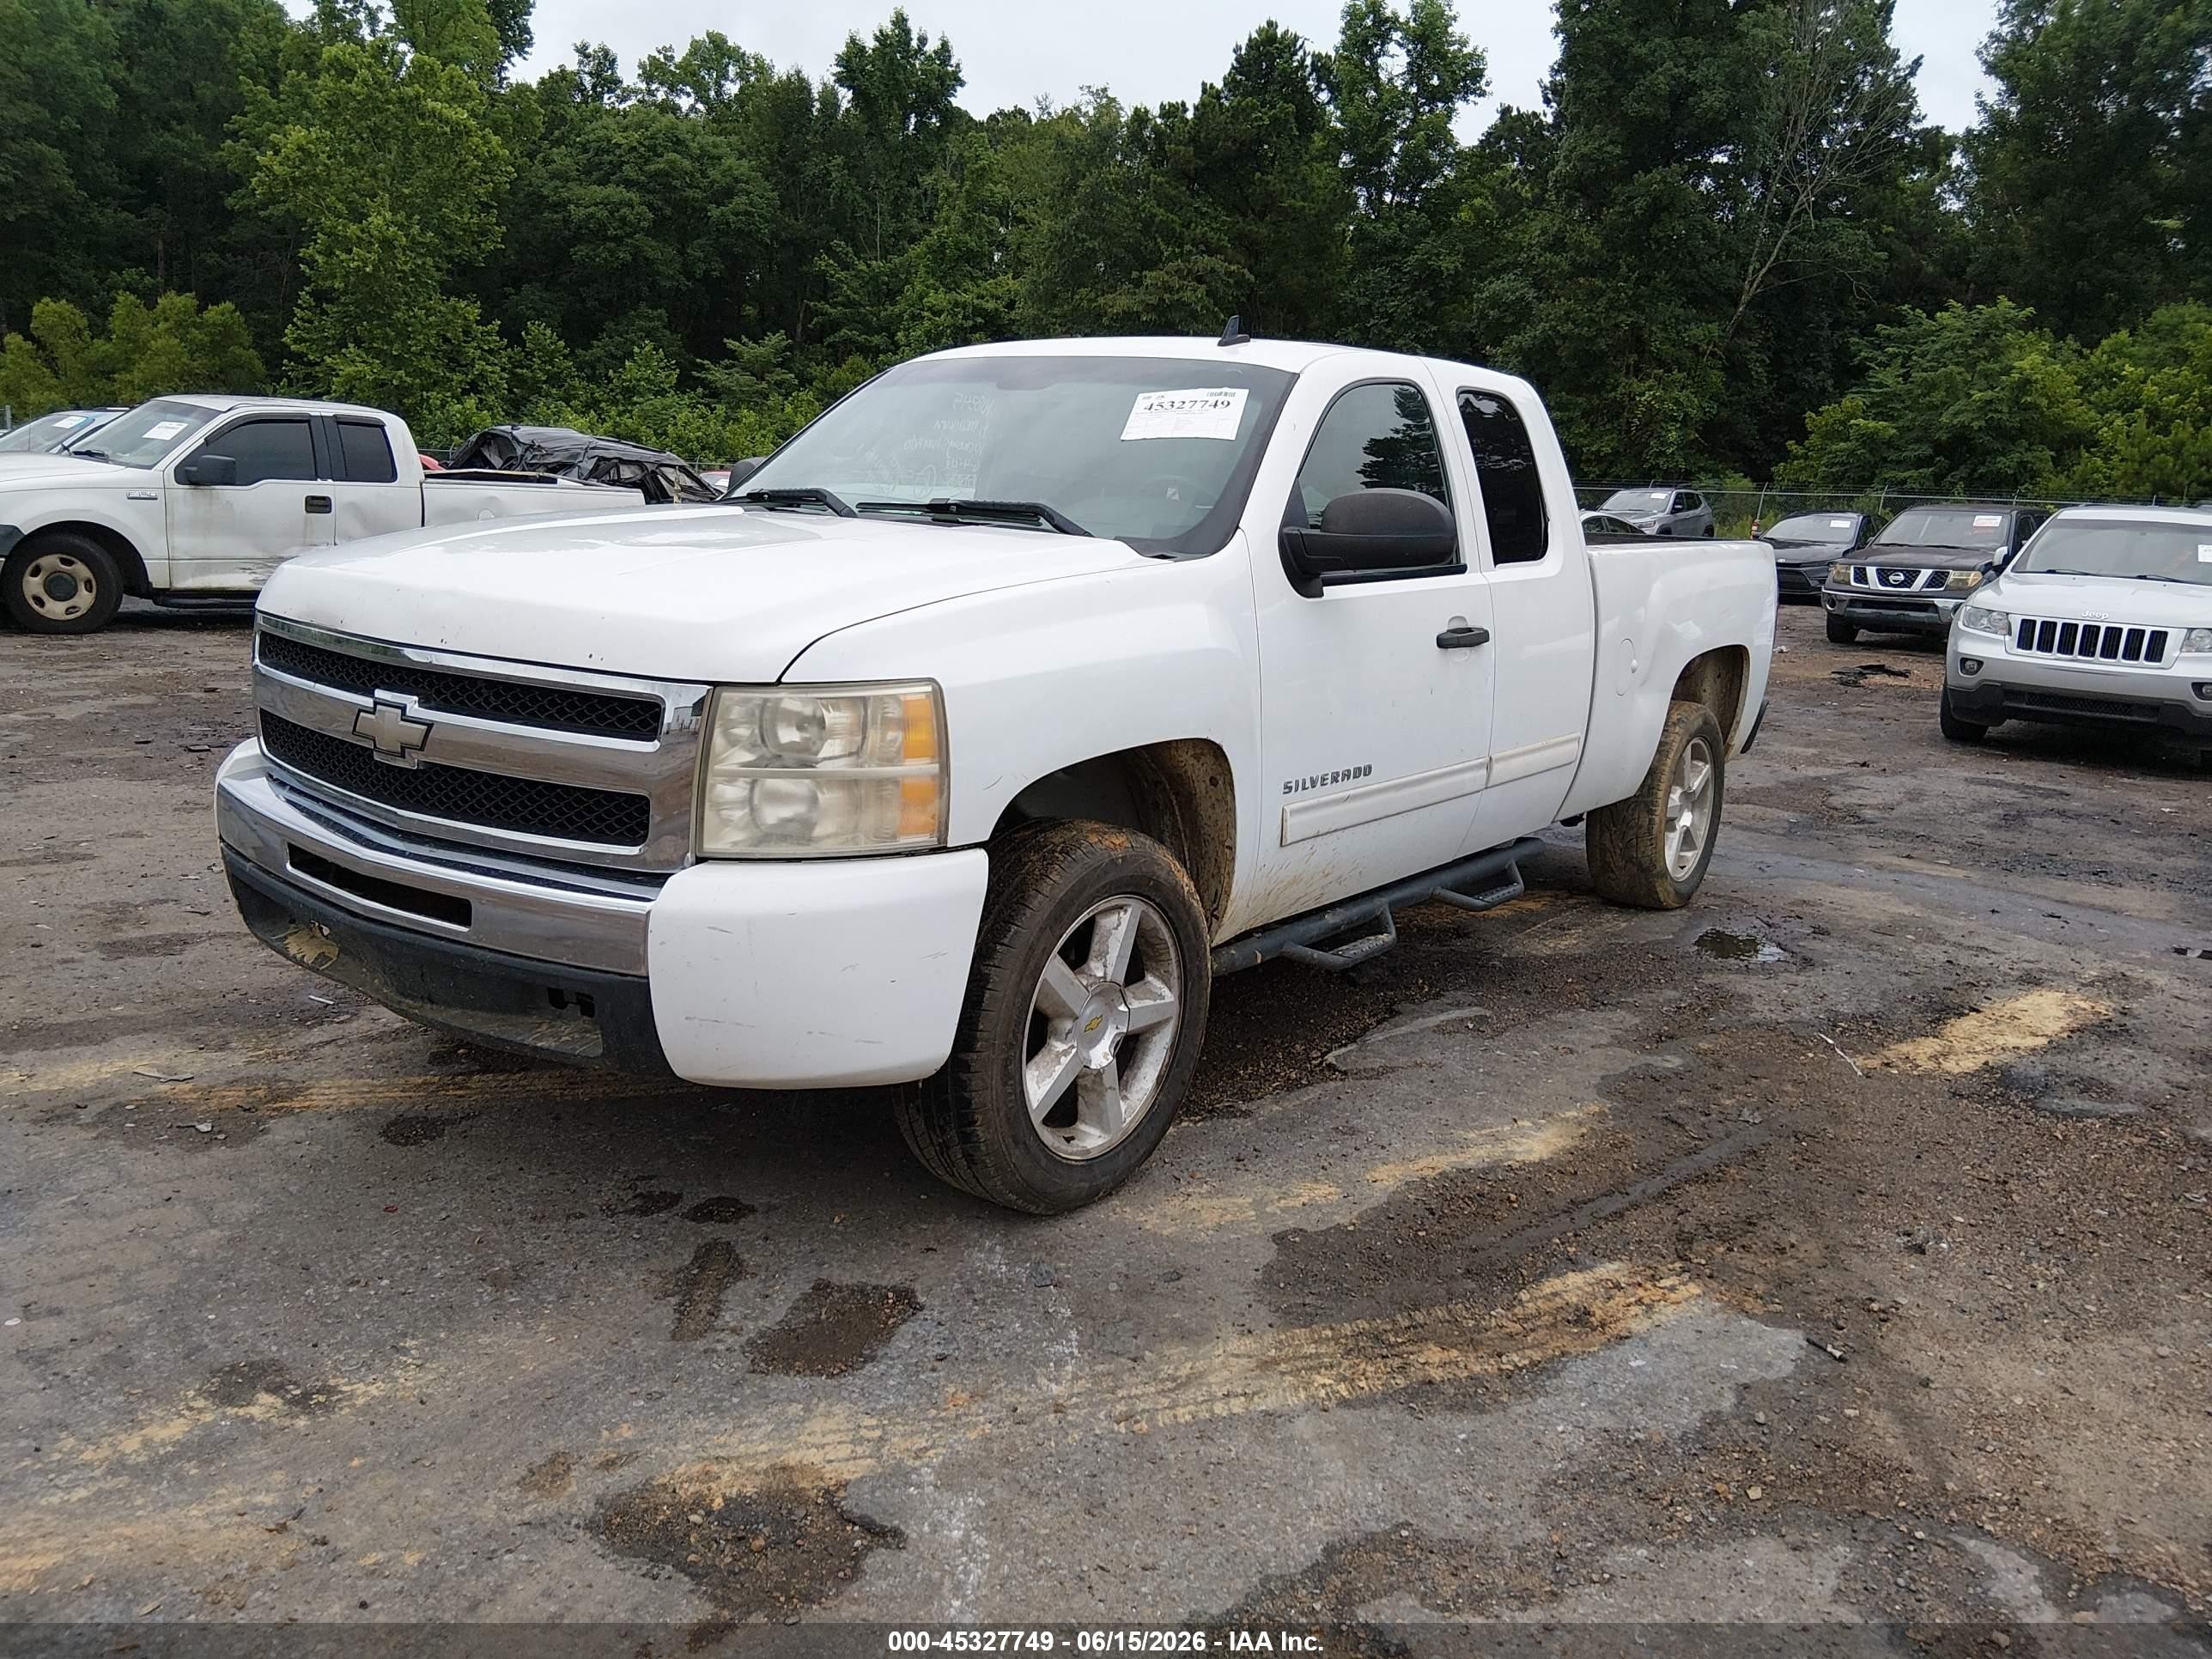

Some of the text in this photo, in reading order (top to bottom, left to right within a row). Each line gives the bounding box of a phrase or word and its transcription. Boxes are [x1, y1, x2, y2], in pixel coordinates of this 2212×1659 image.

[1144, 398, 1231, 412] 45327749
[2081, 610, 2109, 621] Jeep
[1282, 763, 1373, 795] SILVERADO
